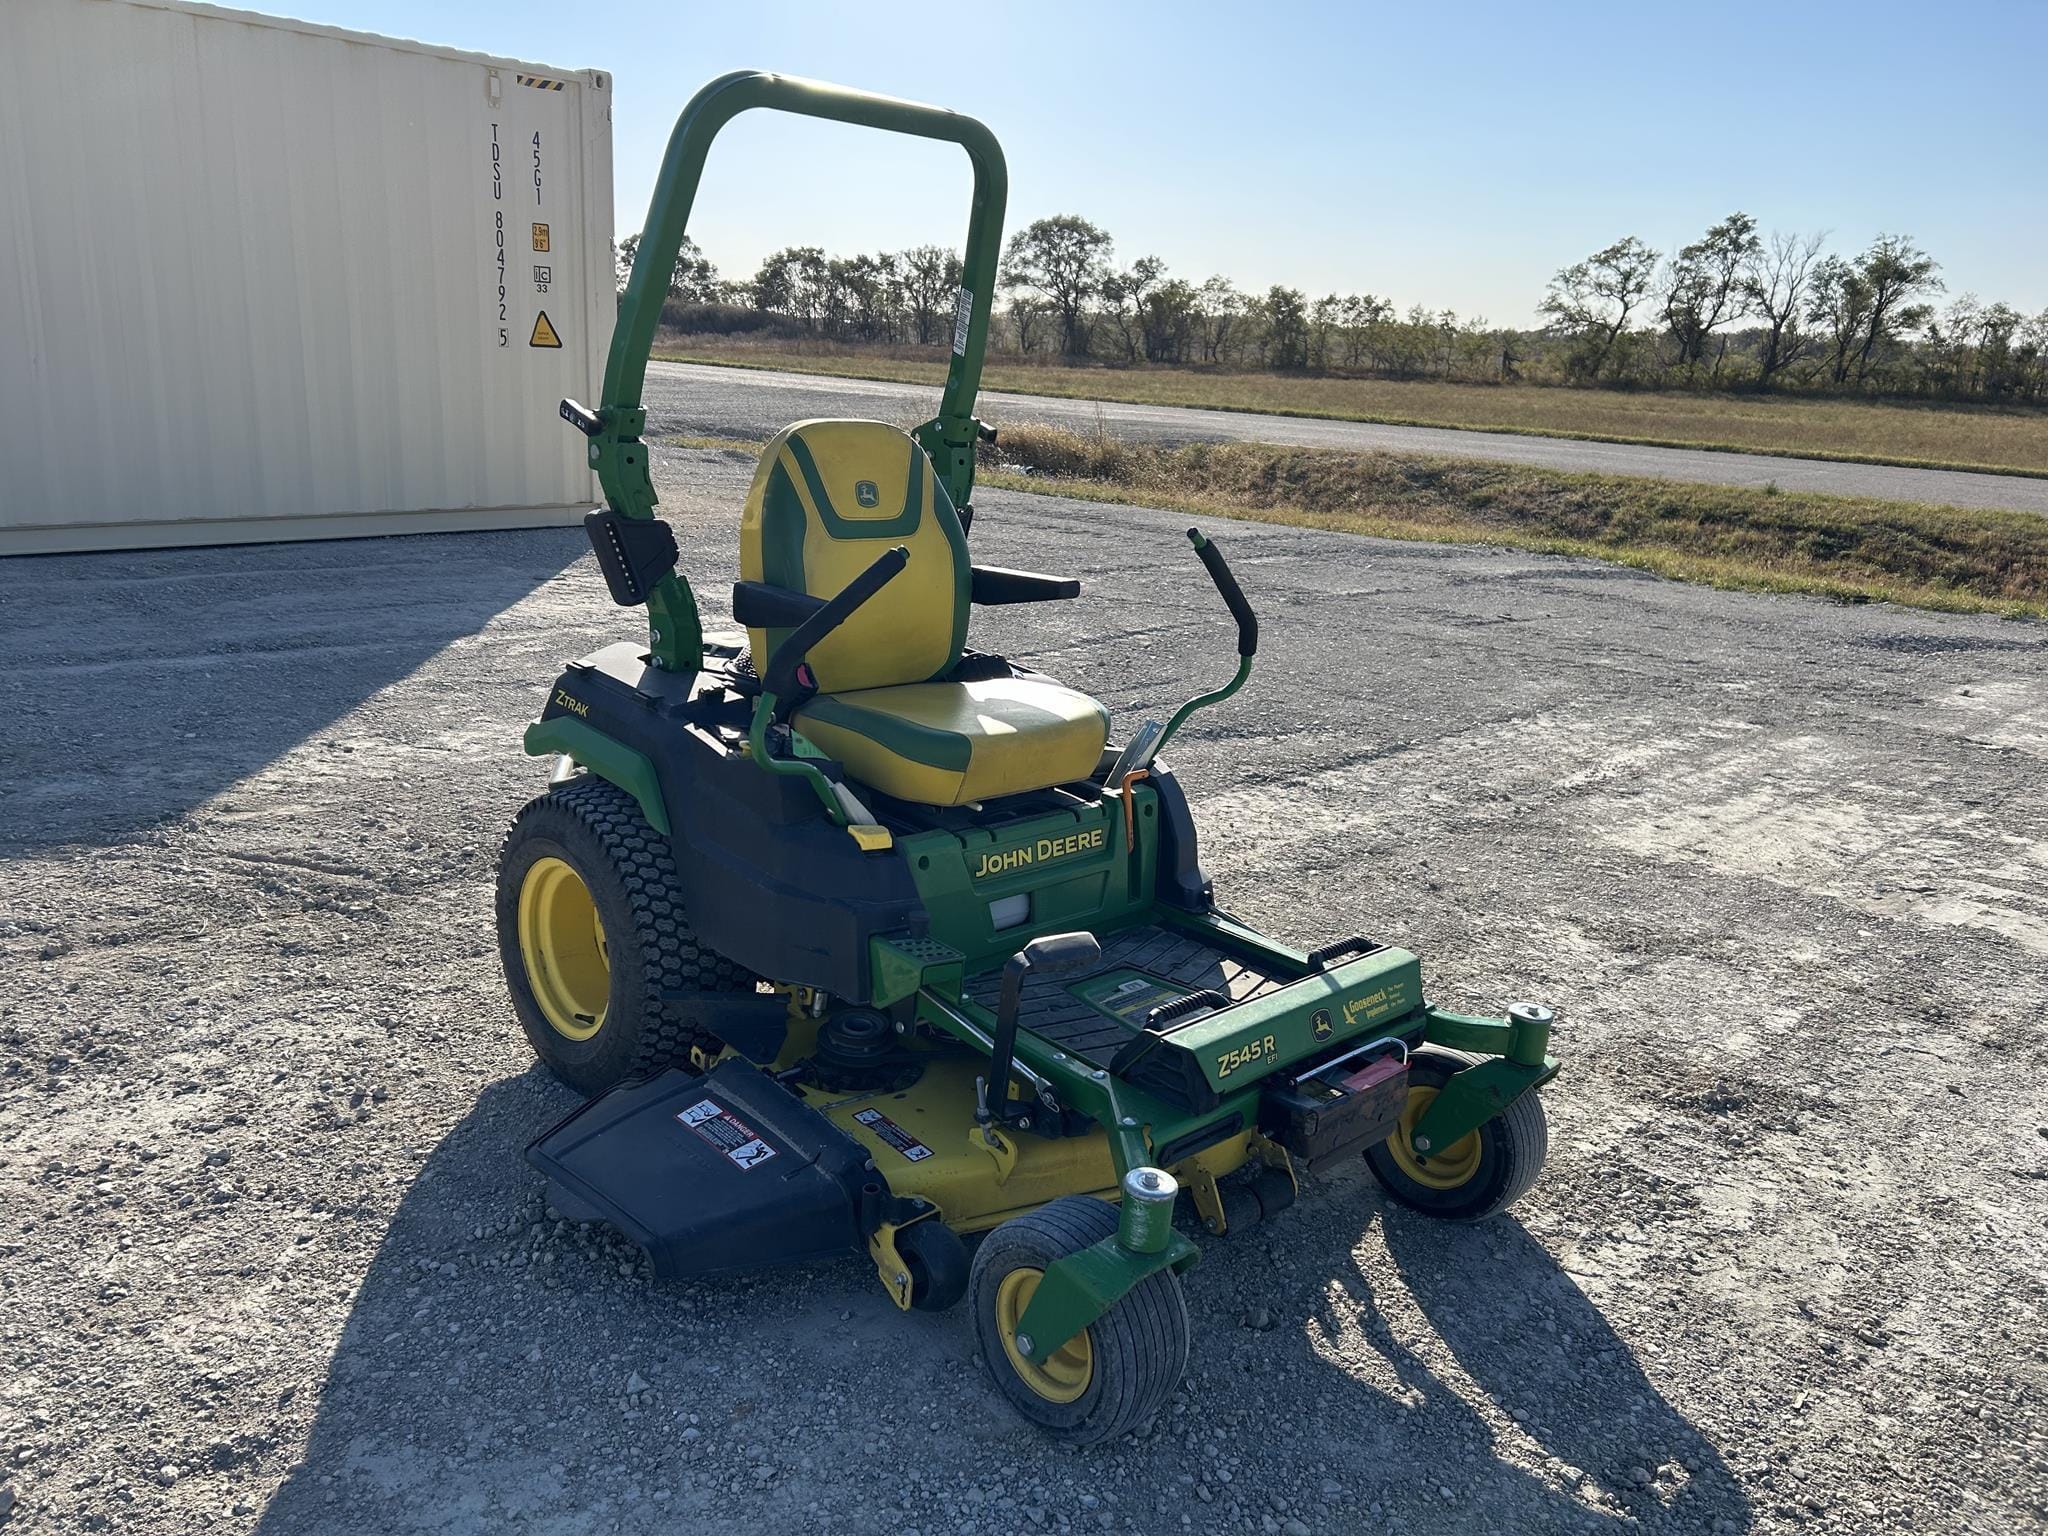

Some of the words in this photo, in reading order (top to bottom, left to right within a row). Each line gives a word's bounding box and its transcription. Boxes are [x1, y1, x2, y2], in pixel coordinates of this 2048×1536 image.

[491, 123, 501, 200] TDSU
[532, 131, 542, 205] 45G1
[495, 211, 506, 320] 804792
[536, 283, 548, 293] 33
[500, 329, 507, 346] 5
[555, 689, 589, 717] ZTRAK
[975, 846, 1032, 878] JOHN
[1037, 829, 1102, 862] DEERE
[1349, 988, 1387, 1013] Gooseneck
[1217, 1040, 1261, 1079] Z545
[1263, 1035, 1276, 1054] R
[1267, 1053, 1279, 1065] EFI
[729, 1118, 755, 1138] DANGER
